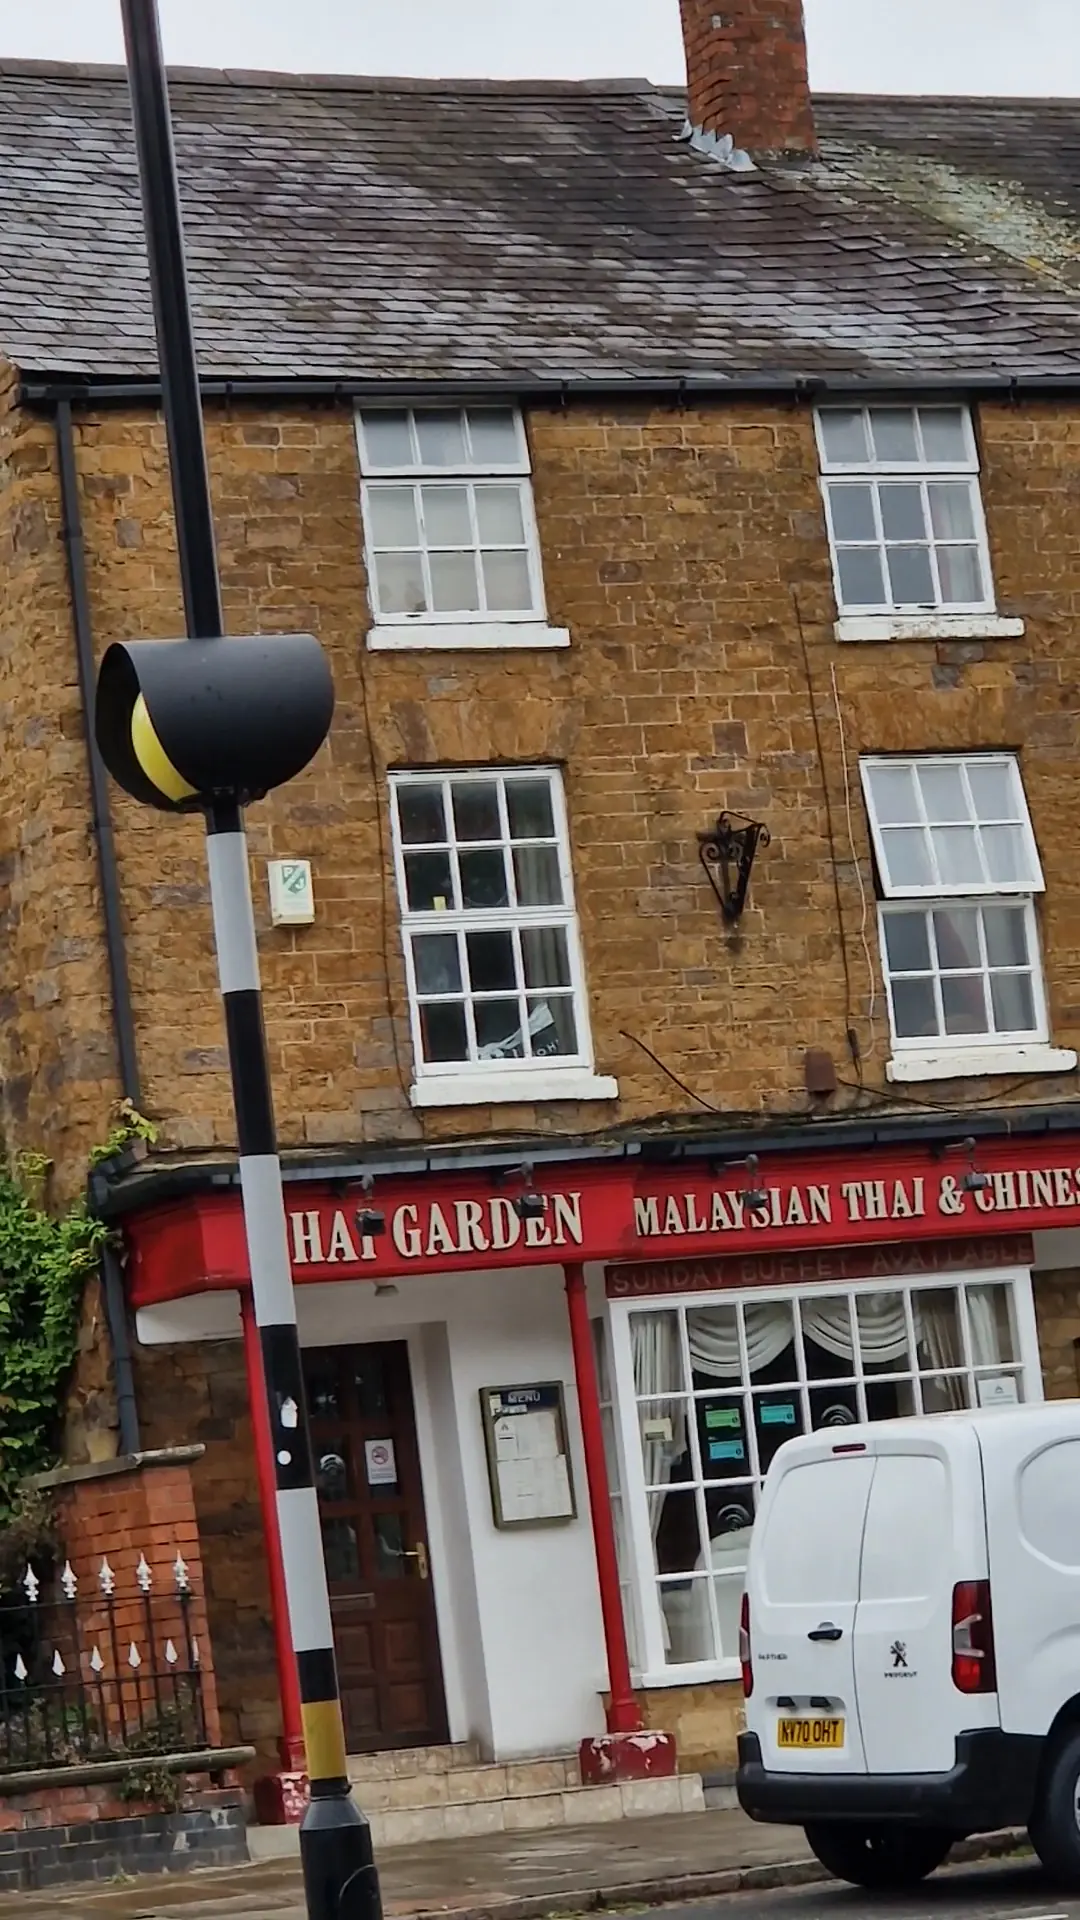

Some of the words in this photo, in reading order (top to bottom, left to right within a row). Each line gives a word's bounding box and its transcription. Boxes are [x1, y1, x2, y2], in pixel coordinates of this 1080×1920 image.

[289, 1208, 377, 1263] HAI
[393, 1193, 583, 1258] GARDEN
[633, 1184, 832, 1236] MALAYSIAN
[842, 1177, 926, 1222] THAI
[938, 1175, 966, 1215] &
[612, 1262, 726, 1293] SUNDAY
[741, 1250, 850, 1282] BUFFET
[872, 1240, 1032, 1274] AVAILABLE
[507, 1391, 541, 1403] MENU
[813, 1719, 839, 1742] OHT
